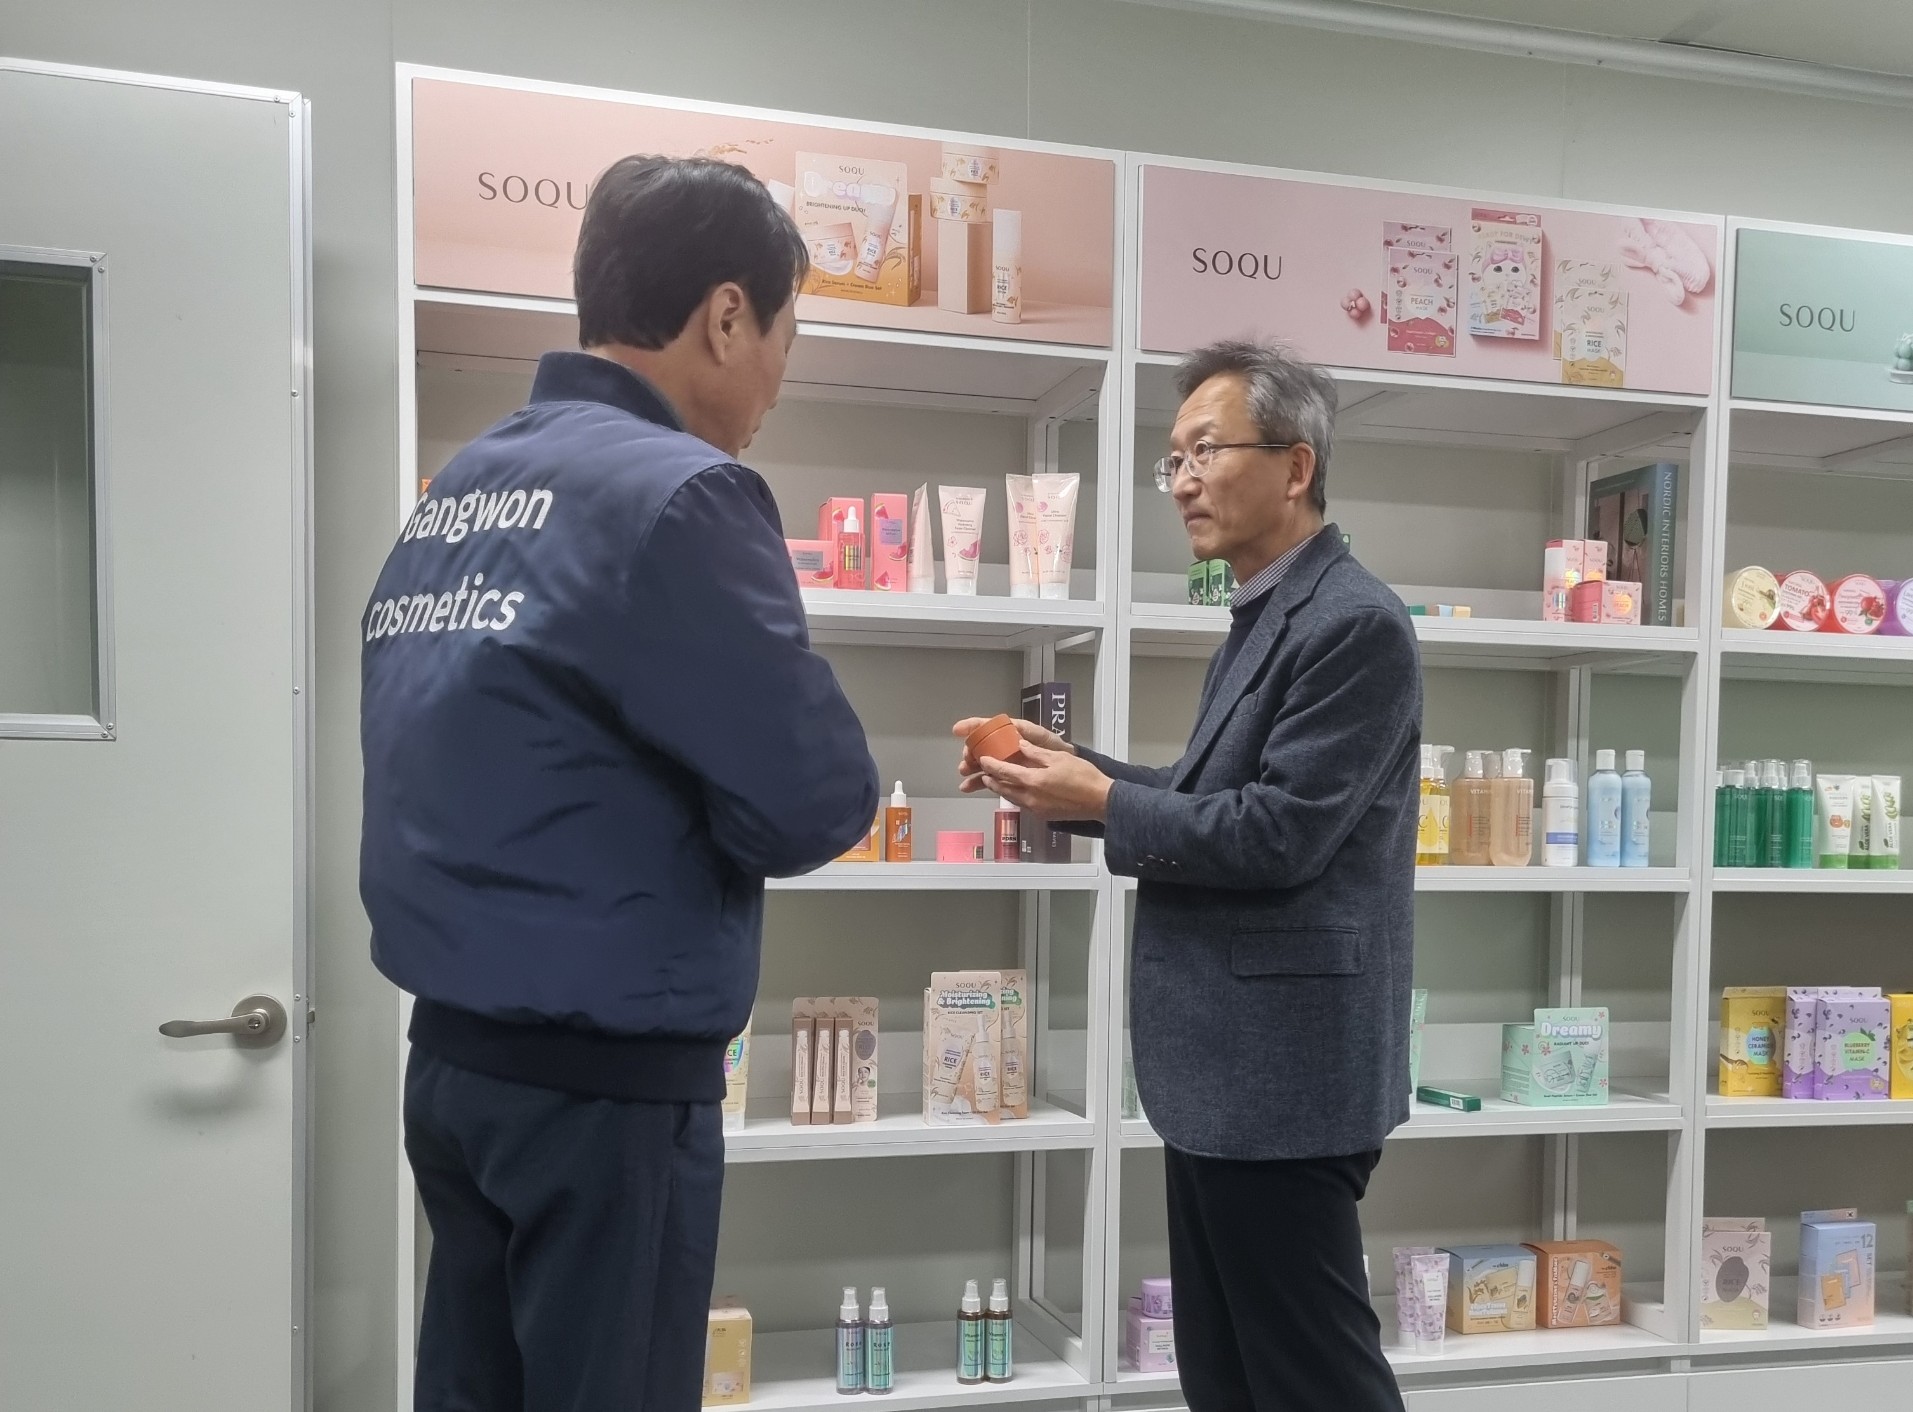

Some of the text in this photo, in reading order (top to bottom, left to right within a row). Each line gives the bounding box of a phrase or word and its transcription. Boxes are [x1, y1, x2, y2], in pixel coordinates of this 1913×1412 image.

[478, 172, 588, 210] SOQU
[1192, 247, 1282, 280] SOQU
[1779, 303, 1856, 332] SOQU
[403, 488, 554, 543] Gangwon
[1658, 471, 1673, 621] NORDIC INTERIORS HOMES
[1784, 584, 1810, 596] TOMATO
[366, 572, 525, 642] cosmetics
[940, 990, 988, 999] Moisturizing
[946, 997, 991, 1006] Brightening
[1540, 1022, 1602, 1040] Dreamy
[1861, 1234, 1873, 1248] 12
